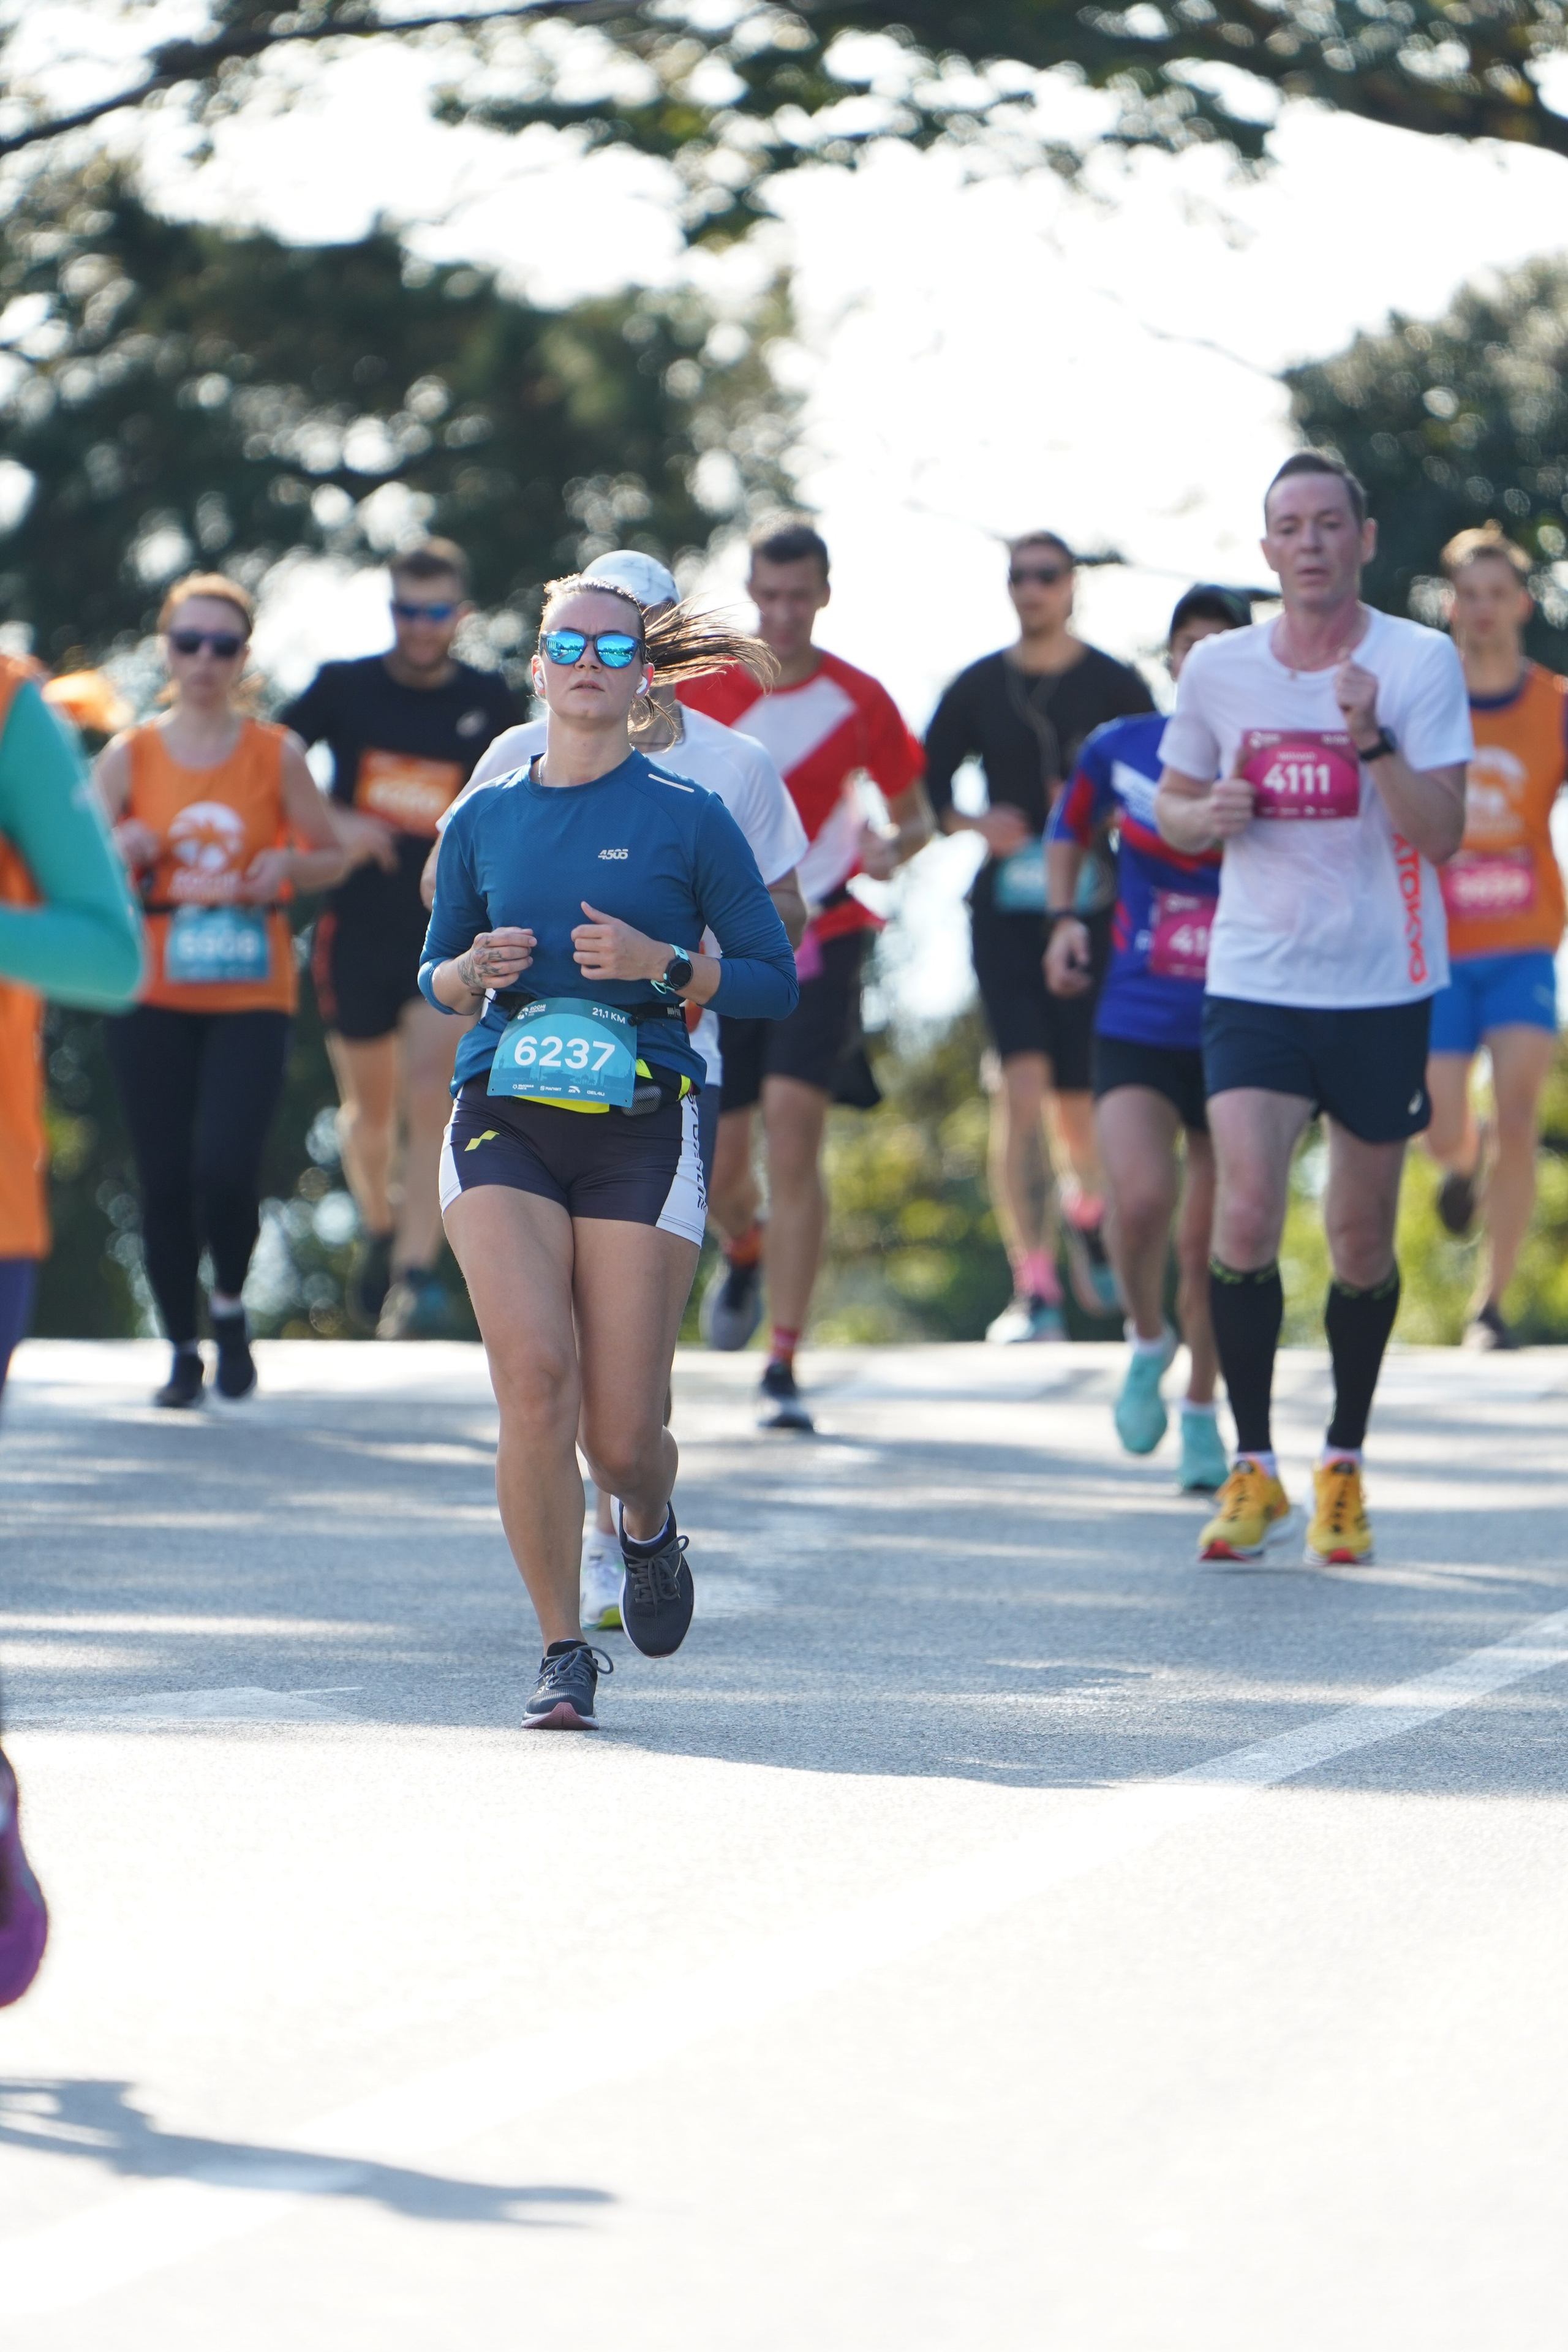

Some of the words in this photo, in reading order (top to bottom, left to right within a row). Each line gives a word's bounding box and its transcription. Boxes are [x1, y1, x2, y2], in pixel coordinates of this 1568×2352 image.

[1262, 763, 1330, 795] 4111
[598, 848, 628, 860] 4505
[1167, 923, 1209, 958] 41
[592, 1007, 609, 1019] 21,1
[611, 1012, 625, 1024] KM
[514, 1035, 616, 1071] 6237
